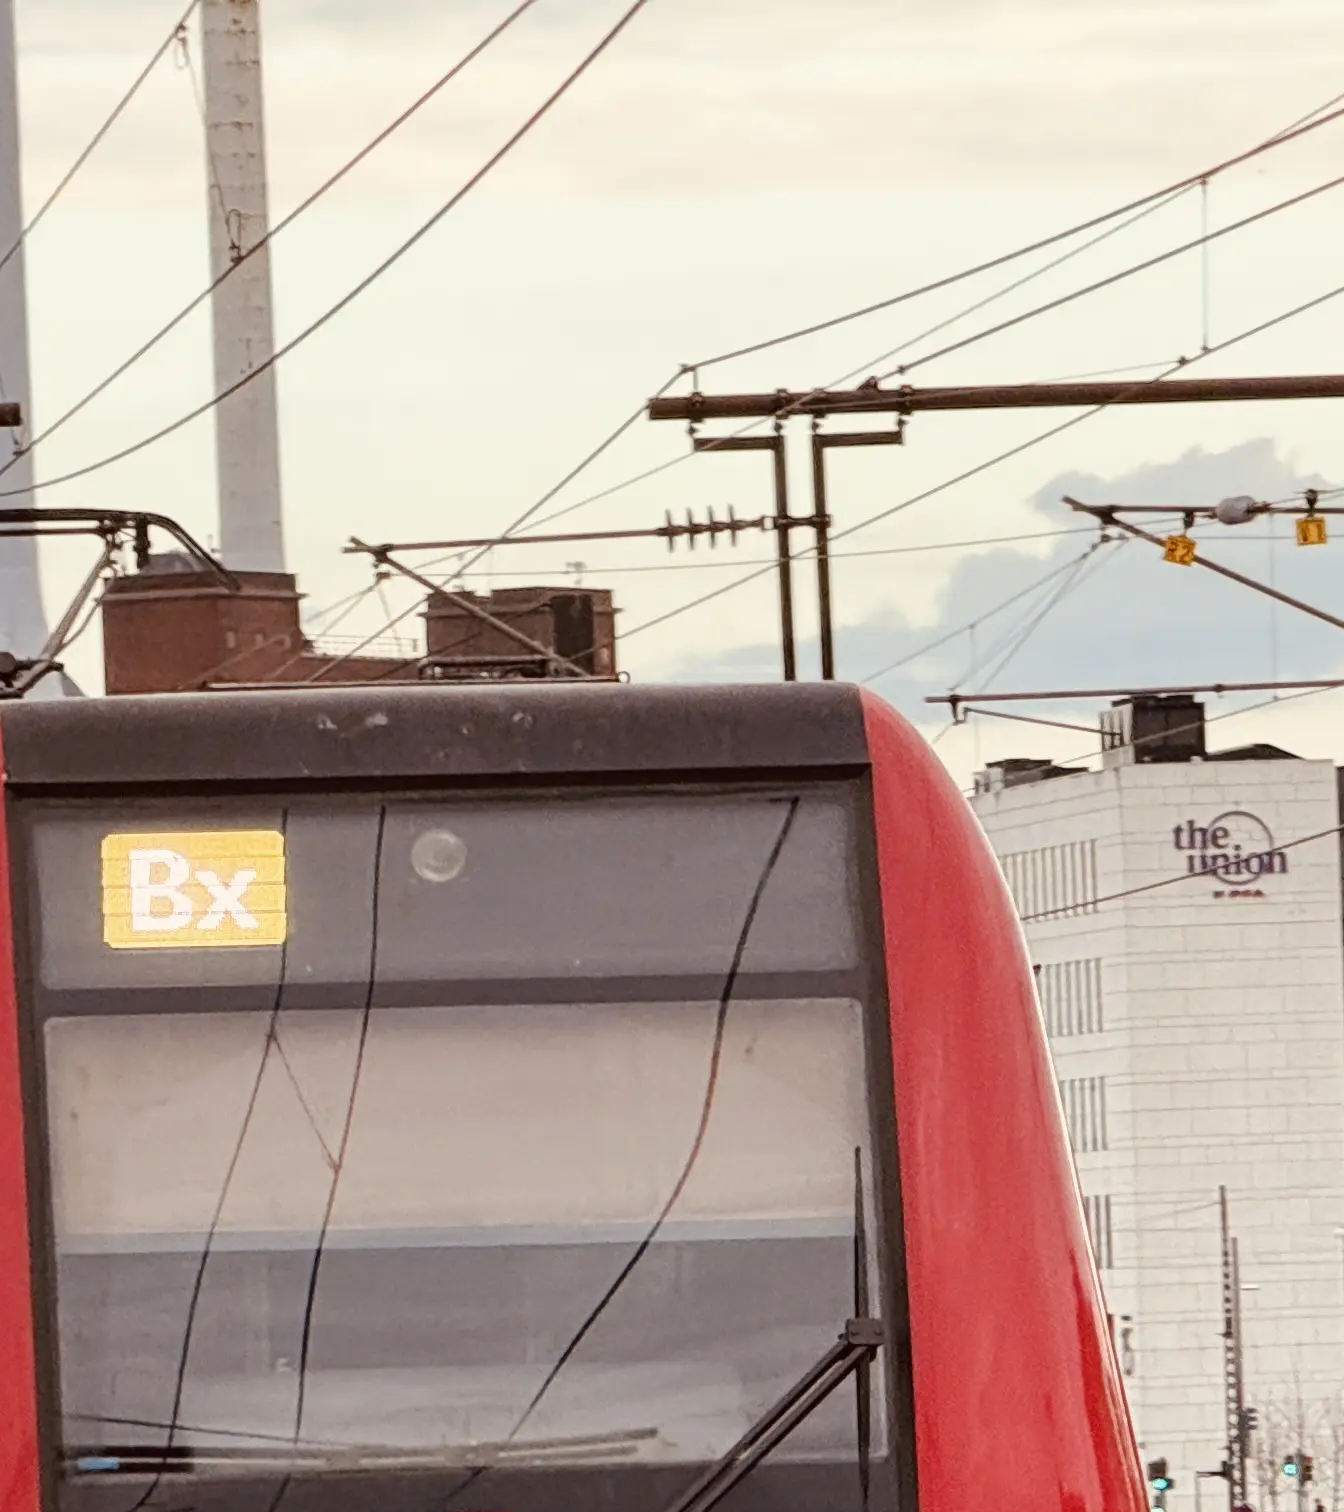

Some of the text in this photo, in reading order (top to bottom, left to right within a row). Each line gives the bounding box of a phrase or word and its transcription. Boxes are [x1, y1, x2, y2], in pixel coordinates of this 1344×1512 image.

[1173, 819, 1230, 850] the
[1186, 844, 1288, 876] union
[128, 849, 258, 931] Bx
